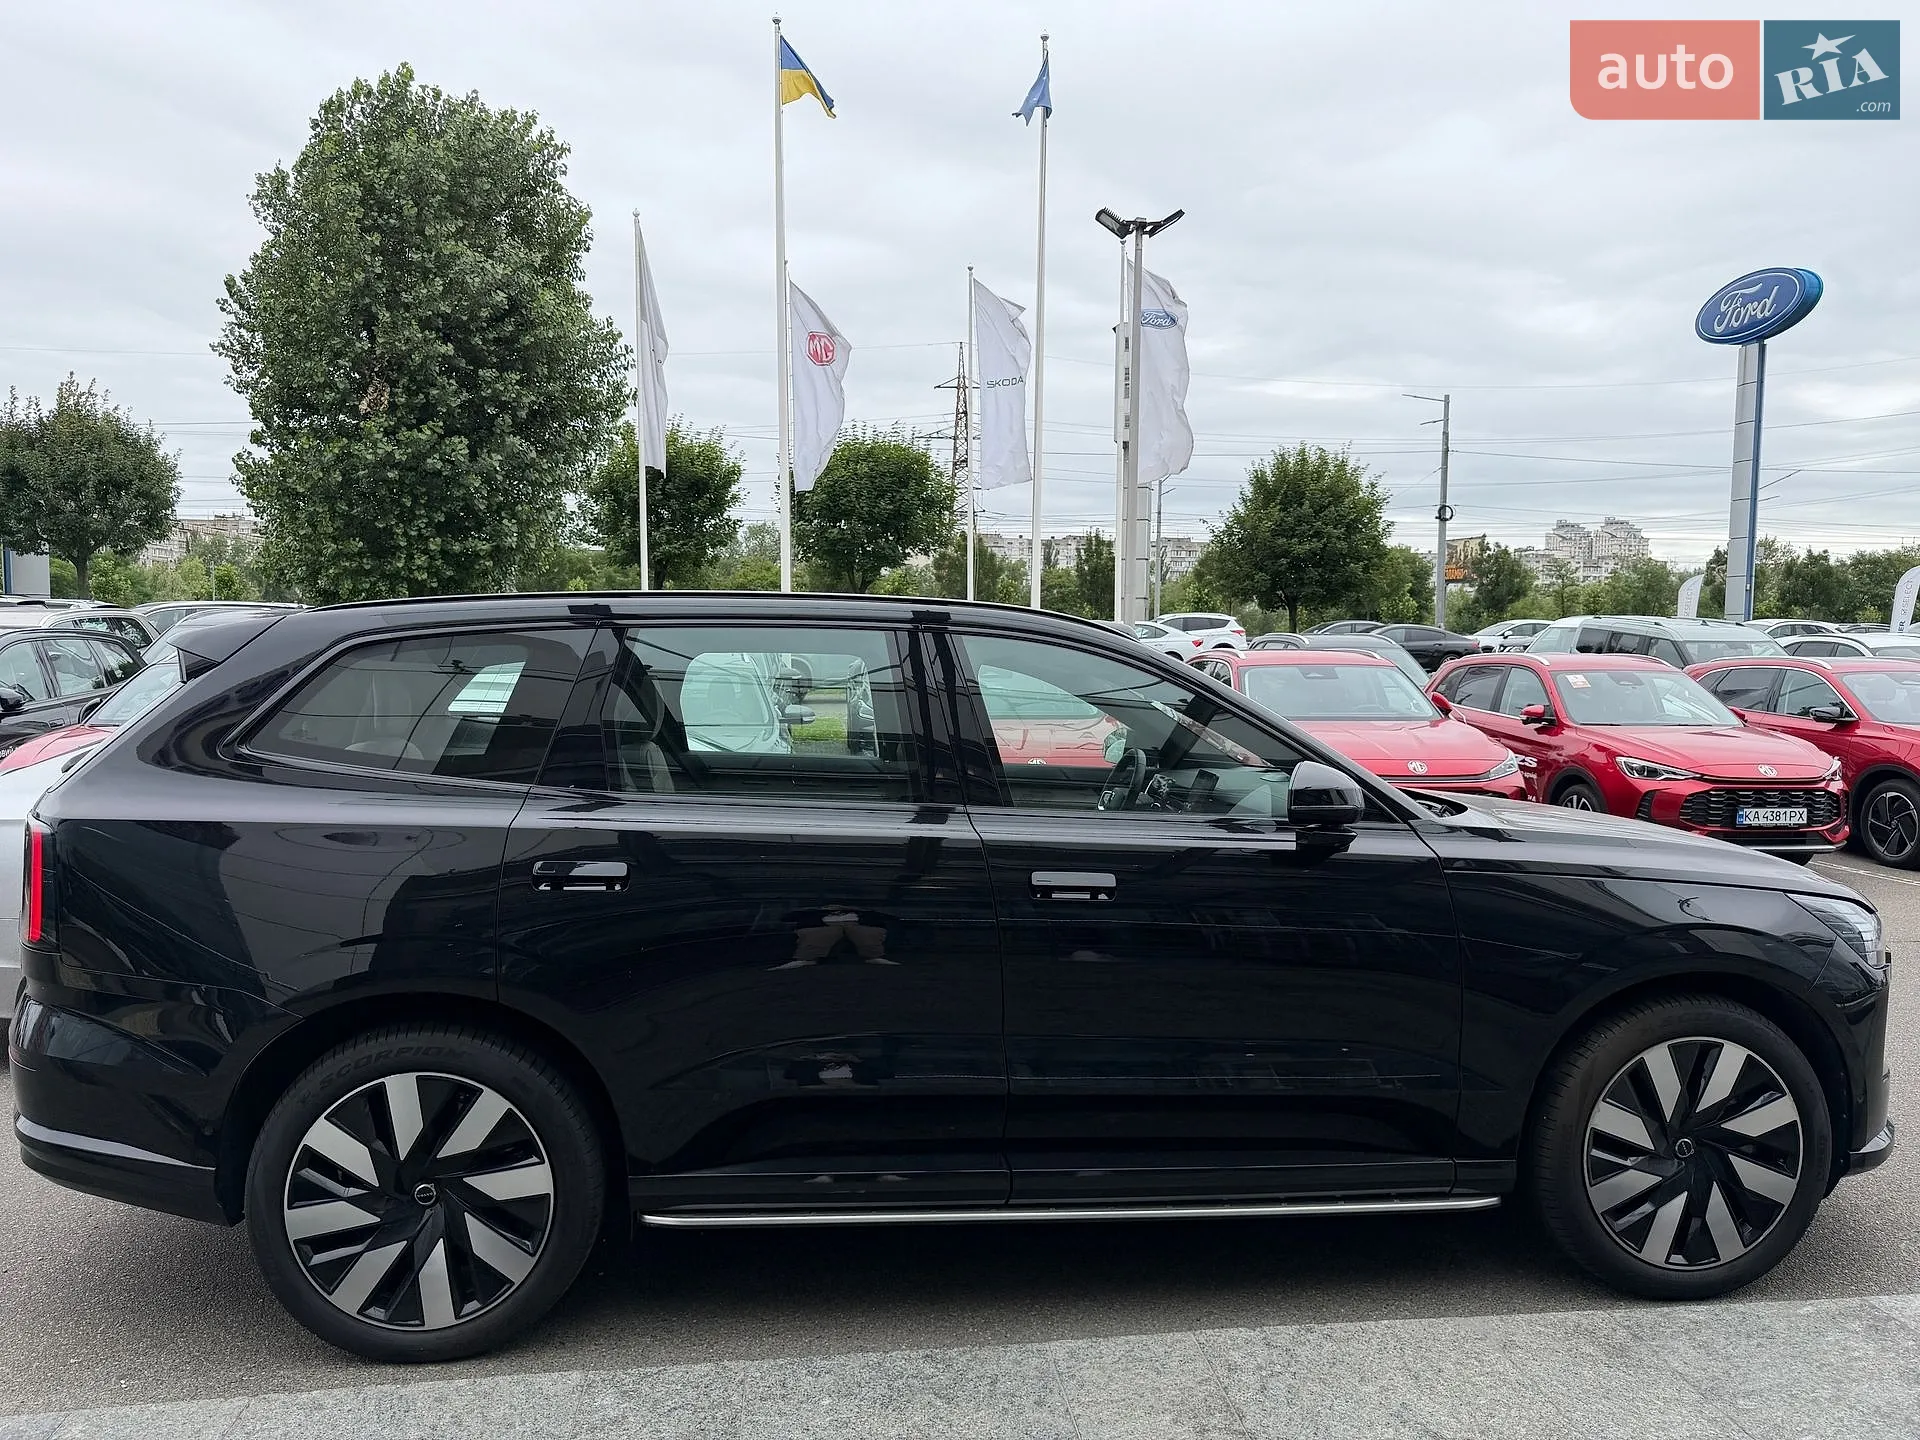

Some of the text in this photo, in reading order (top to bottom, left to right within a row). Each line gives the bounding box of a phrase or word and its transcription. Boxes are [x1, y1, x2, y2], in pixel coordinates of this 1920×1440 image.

[1142, 311, 1172, 326] Ford
[1713, 282, 1780, 333] Ford
[808, 333, 835, 363] MG
[1744, 810, 1760, 822] KA
[1762, 810, 1788, 822] 4381
[1789, 810, 1805, 822] PX
